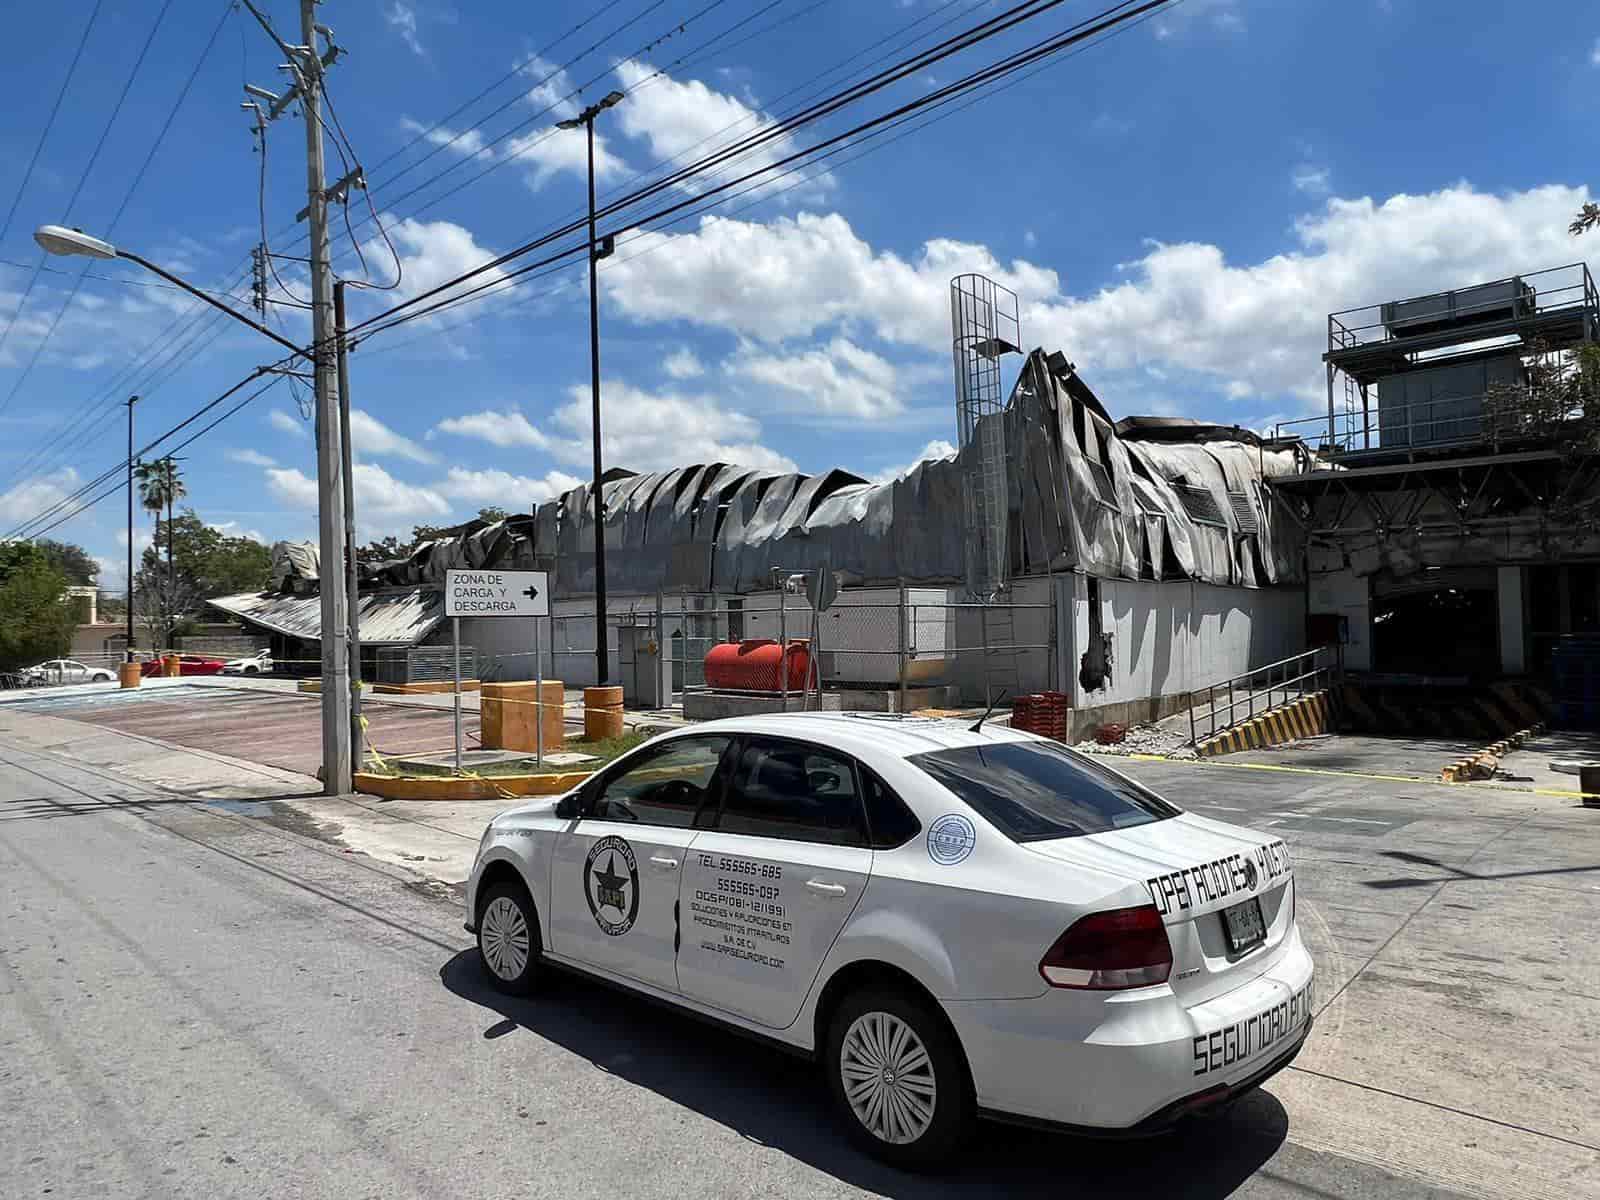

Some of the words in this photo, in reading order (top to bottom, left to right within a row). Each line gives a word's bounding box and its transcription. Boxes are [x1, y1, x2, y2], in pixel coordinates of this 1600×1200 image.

[454, 574, 485, 585] ZONA
[487, 574, 503, 585] DE
[454, 587, 495, 598] CARGA
[499, 588, 506, 597] Y
[454, 601, 517, 611] DESCARGA
